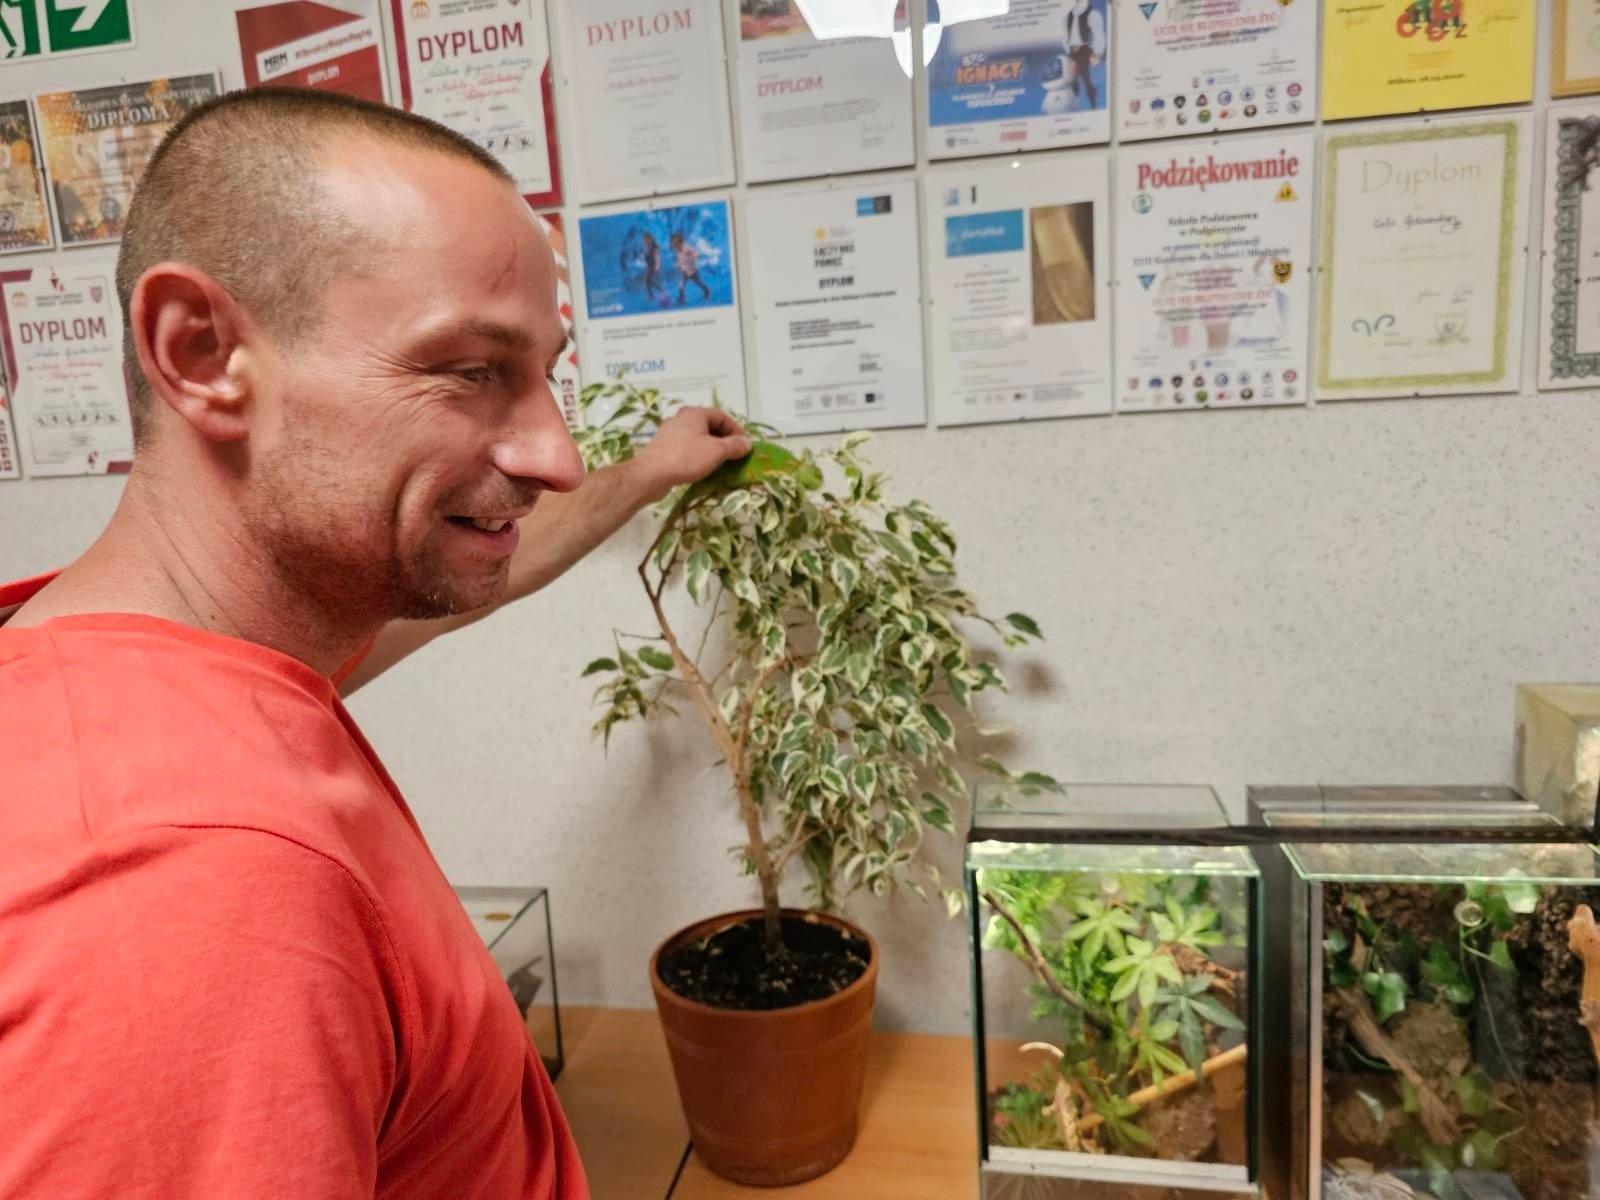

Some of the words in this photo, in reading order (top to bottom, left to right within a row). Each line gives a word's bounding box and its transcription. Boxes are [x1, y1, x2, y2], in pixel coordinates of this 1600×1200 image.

[586, 9, 692, 46] DYPLOM
[417, 22, 524, 62] DYPLOM
[954, 59, 1023, 85] IGNACY
[757, 75, 823, 97] DYPLOM
[87, 105, 170, 129] DIPLOMA
[1137, 149, 1299, 191] Podziękowanie
[1361, 153, 1481, 196] Dyplom
[819, 276, 855, 290] DYPLOM
[19, 317, 107, 344] DYPLOM
[605, 359, 665, 377] DYPLOM
